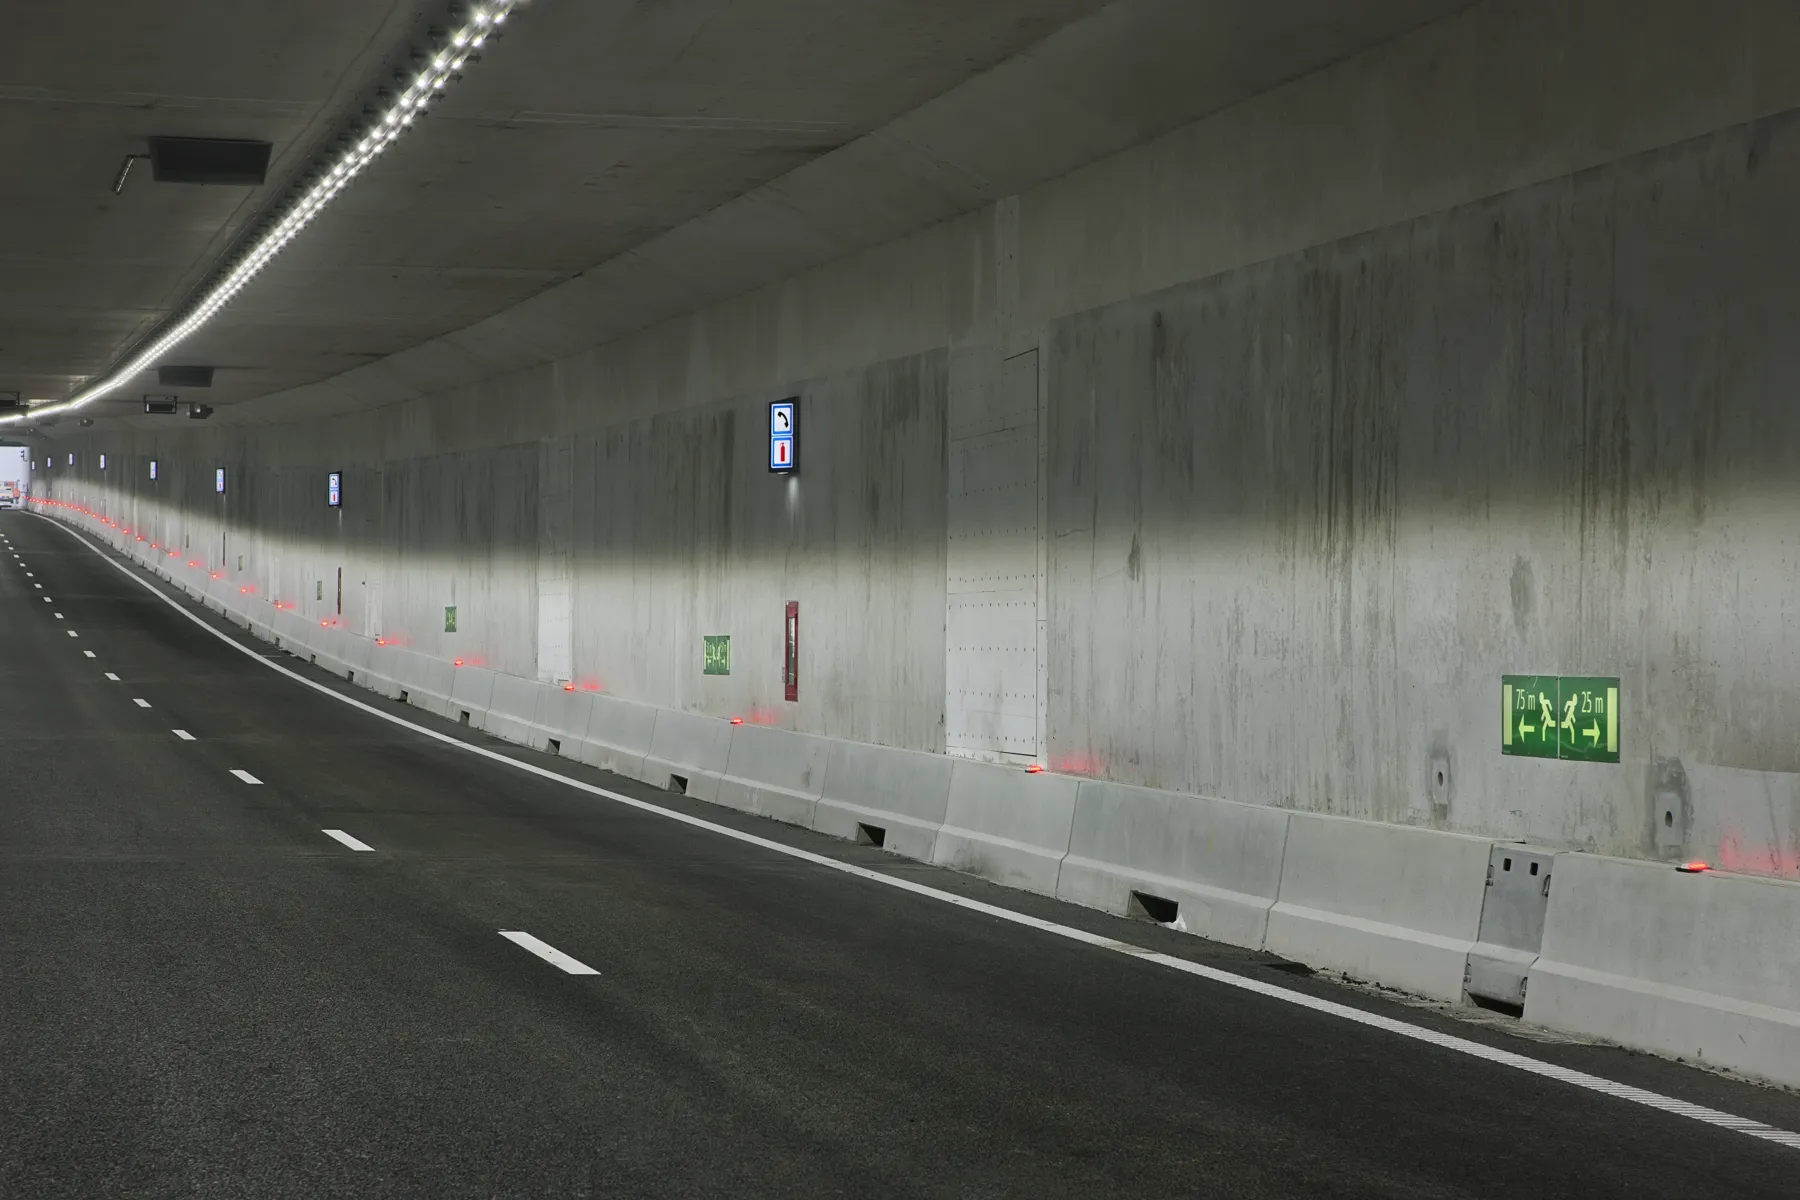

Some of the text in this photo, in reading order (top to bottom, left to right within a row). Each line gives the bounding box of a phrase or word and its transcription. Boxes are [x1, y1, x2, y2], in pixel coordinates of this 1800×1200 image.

[1516, 689, 1535, 710] 75 m
[1582, 691, 1603, 714] 25 m
